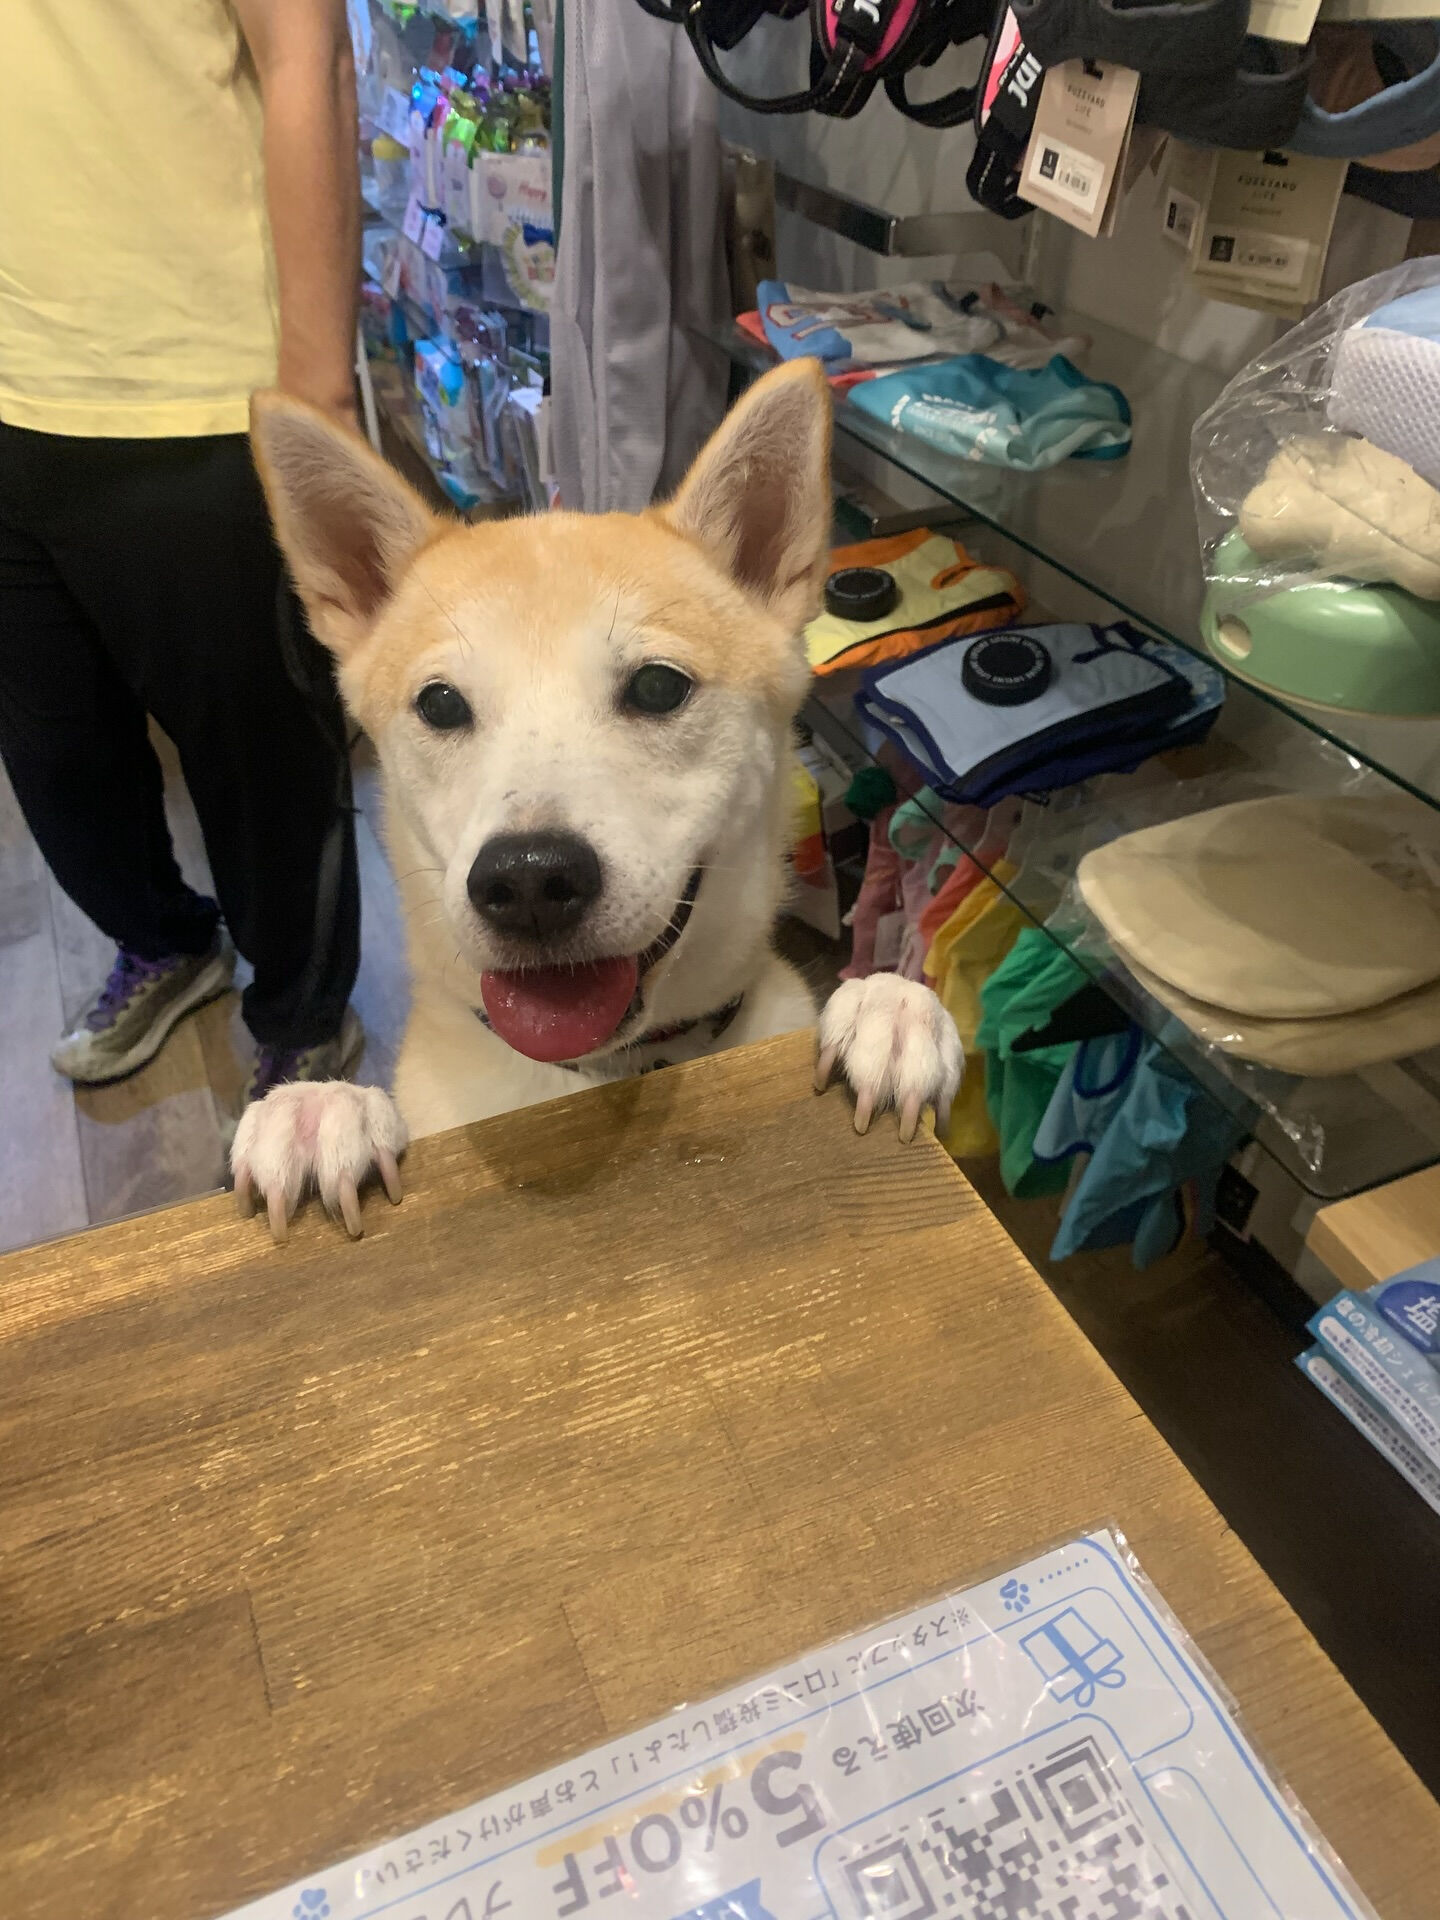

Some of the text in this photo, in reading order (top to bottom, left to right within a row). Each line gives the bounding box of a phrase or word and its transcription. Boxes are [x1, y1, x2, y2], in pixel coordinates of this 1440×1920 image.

[832, 1687, 986, 1777] 次回使える
[552, 1750, 828, 1918] 5%OFF
